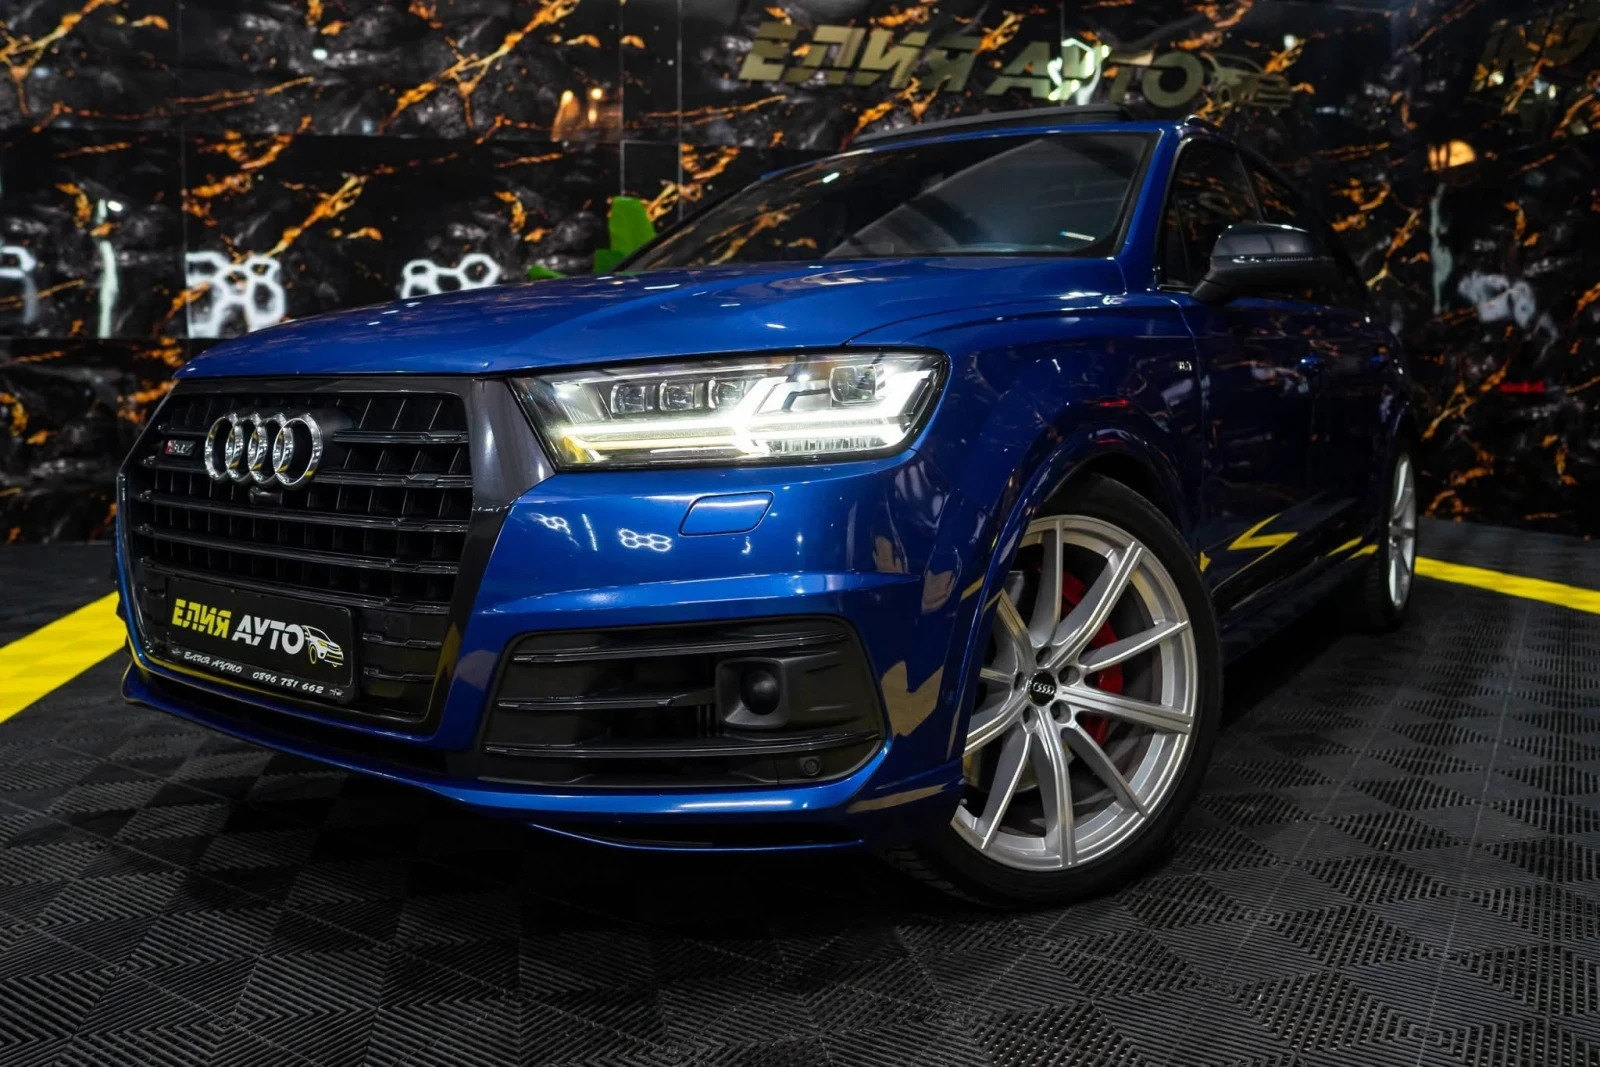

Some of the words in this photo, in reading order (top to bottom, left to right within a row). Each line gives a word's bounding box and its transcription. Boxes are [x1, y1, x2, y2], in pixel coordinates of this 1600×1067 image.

[738, 21, 985, 92] ЕЛИЯ
[985, 39, 1205, 109] АУТО
[172, 598, 232, 639] ЕЛИЯ
[231, 614, 305, 655] АУТО
[252, 672, 278, 684] 0896
[280, 677, 299, 688] 781
[301, 683, 325, 694] 662
